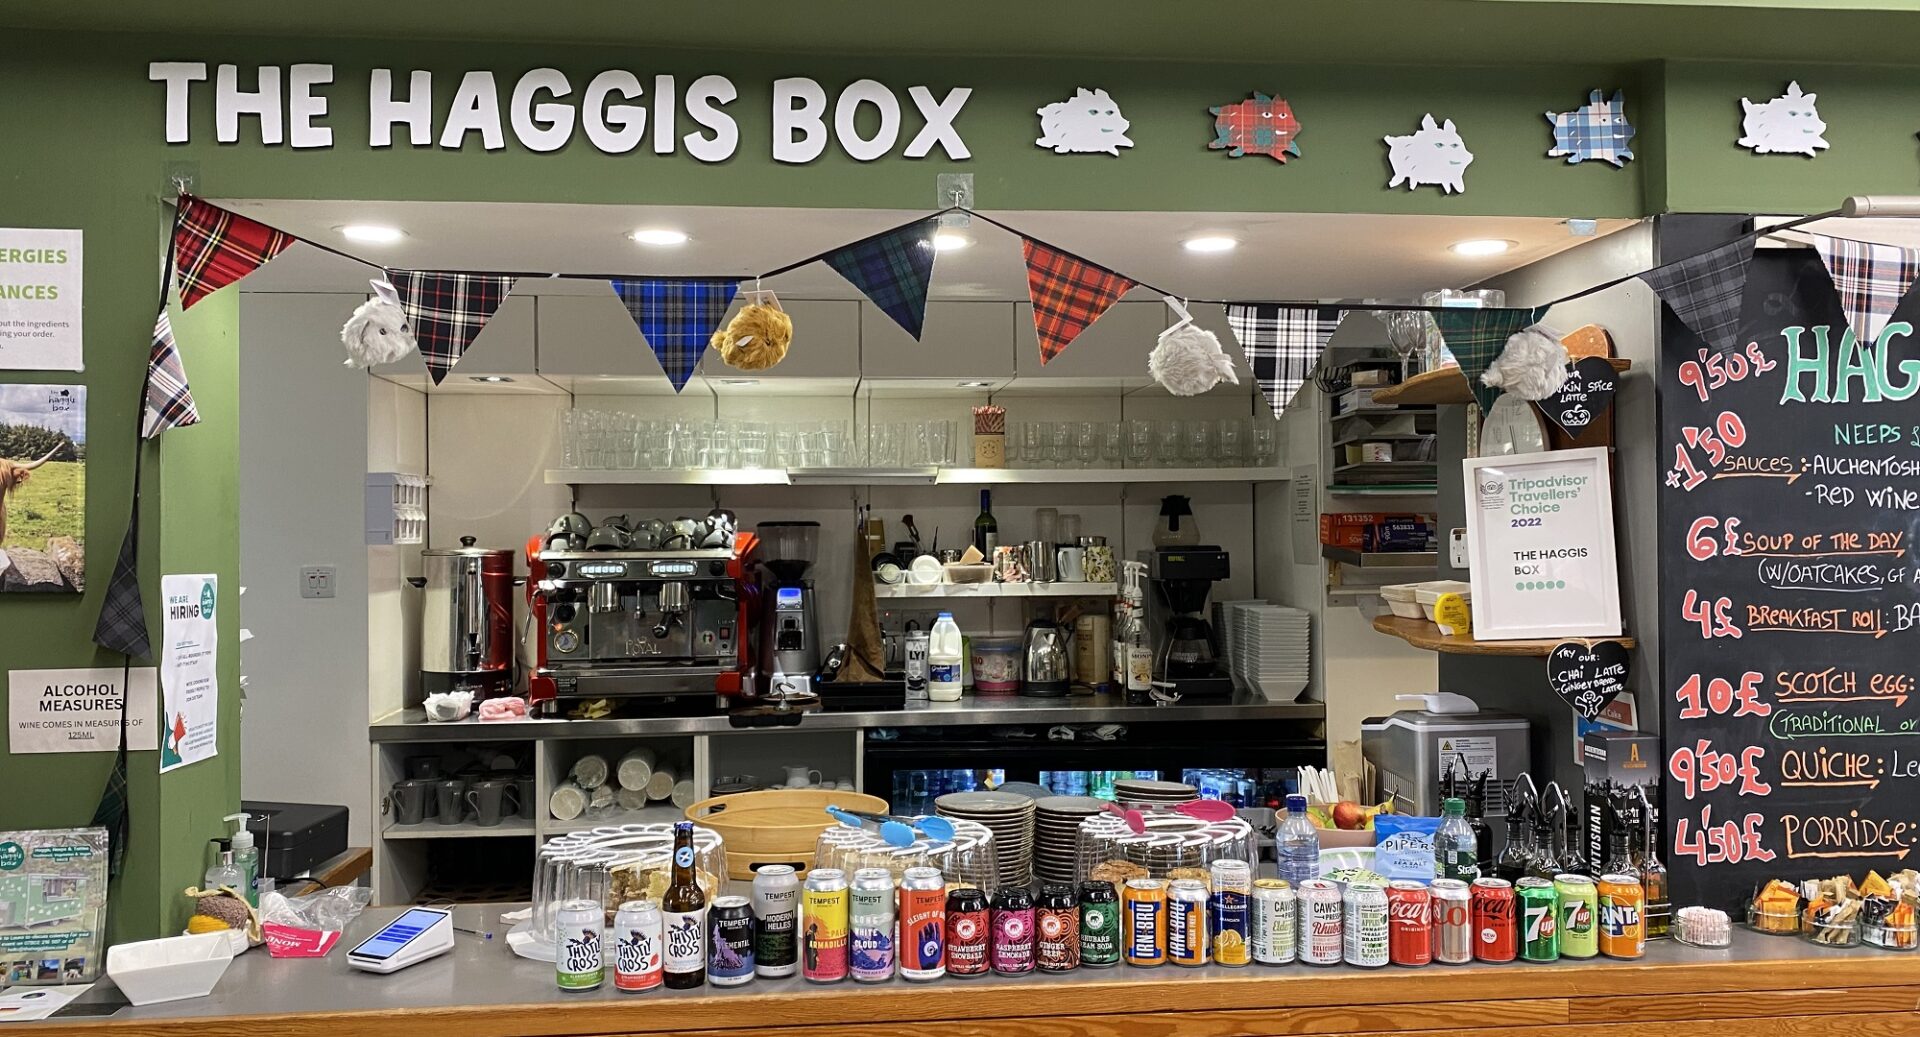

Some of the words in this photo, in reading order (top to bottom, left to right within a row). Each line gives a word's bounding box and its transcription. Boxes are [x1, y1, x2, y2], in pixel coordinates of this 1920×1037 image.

[149, 62, 334, 148] THE
[369, 68, 738, 163] HAGGIS
[772, 78, 973, 163] BOX
[12, 320, 26, 328] the
[27, 320, 69, 329] ingredients
[13, 331, 31, 339] your
[1834, 423, 1901, 446] NEEPS
[1509, 475, 1588, 492] Tripadvisor
[1511, 503, 1561, 515] Choice
[1511, 517, 1542, 528] 2022
[1686, 516, 1743, 561] 6£
[1743, 533, 1794, 553] SOUP
[1801, 534, 1823, 550] OF
[1867, 531, 1903, 550] DAY
[1514, 551, 1537, 561] THE
[1539, 548, 1588, 560] HAGGIS
[1514, 565, 1540, 575] BOX
[170, 604, 200, 620] HIRING
[1682, 588, 1743, 639] 4£
[43, 684, 119, 697] ALCOHOL
[1676, 671, 1772, 720] 10£
[1775, 667, 1857, 697] SCOTCH
[39, 699, 124, 712] MEASURES
[18, 721, 41, 729] WINE
[42, 720, 73, 729] COMES
[74, 720, 83, 728] IN
[85, 719, 130, 728] MEASURS
[132, 718, 144, 727] OF
[1630, 743, 1639, 761] A
[764, 891, 796, 901] TEMPEST
[852, 895, 881, 903] TEMPEST
[719, 918, 750, 928] TEMPEST
[766, 911, 793, 923] MODERN
[907, 911, 930, 926] SLEIGHT
[767, 920, 792, 931] HELLES
[854, 927, 878, 937] WHITE
[668, 922, 701, 944] THISTLY
[566, 933, 601, 958] THISTLY
[617, 937, 651, 958] THISTLY
[668, 941, 700, 958] CROSS
[809, 938, 847, 949] ARMADILLO
[854, 940, 878, 949] CLOUD
[996, 943, 1031, 951] RASPBERRY
[998, 950, 1031, 958] LEMONADE
[566, 954, 599, 972] CROSS
[617, 955, 649, 972] CROSS
